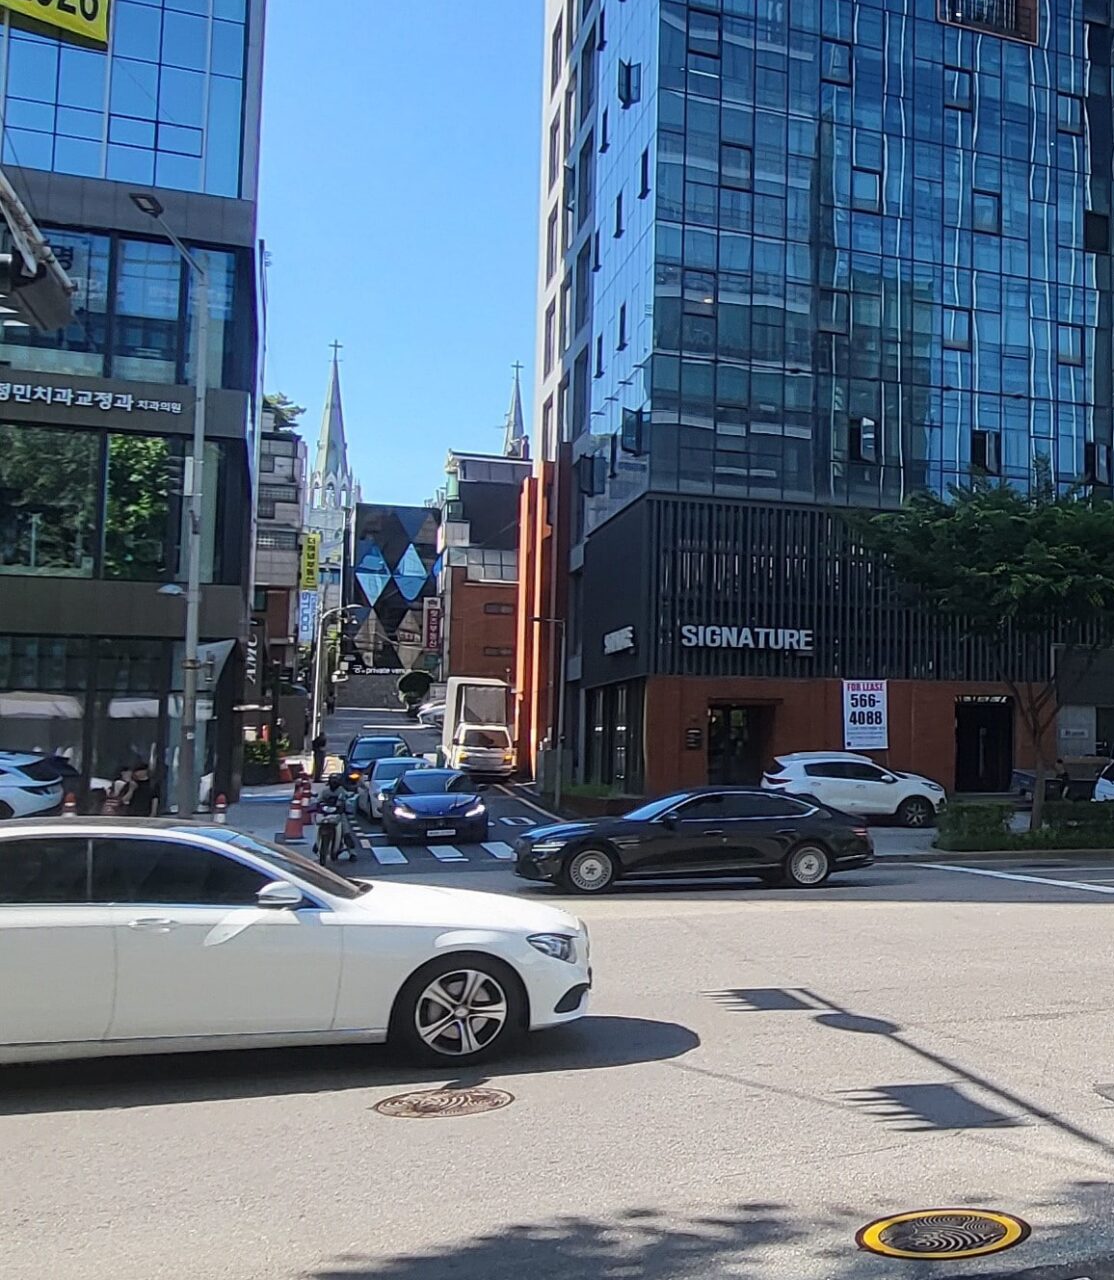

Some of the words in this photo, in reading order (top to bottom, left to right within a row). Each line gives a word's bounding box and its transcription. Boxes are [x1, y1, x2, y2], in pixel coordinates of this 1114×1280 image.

[681, 625, 813, 650] SIGNATURE
[850, 693, 881, 708] 566-
[849, 710, 883, 726] 4088
